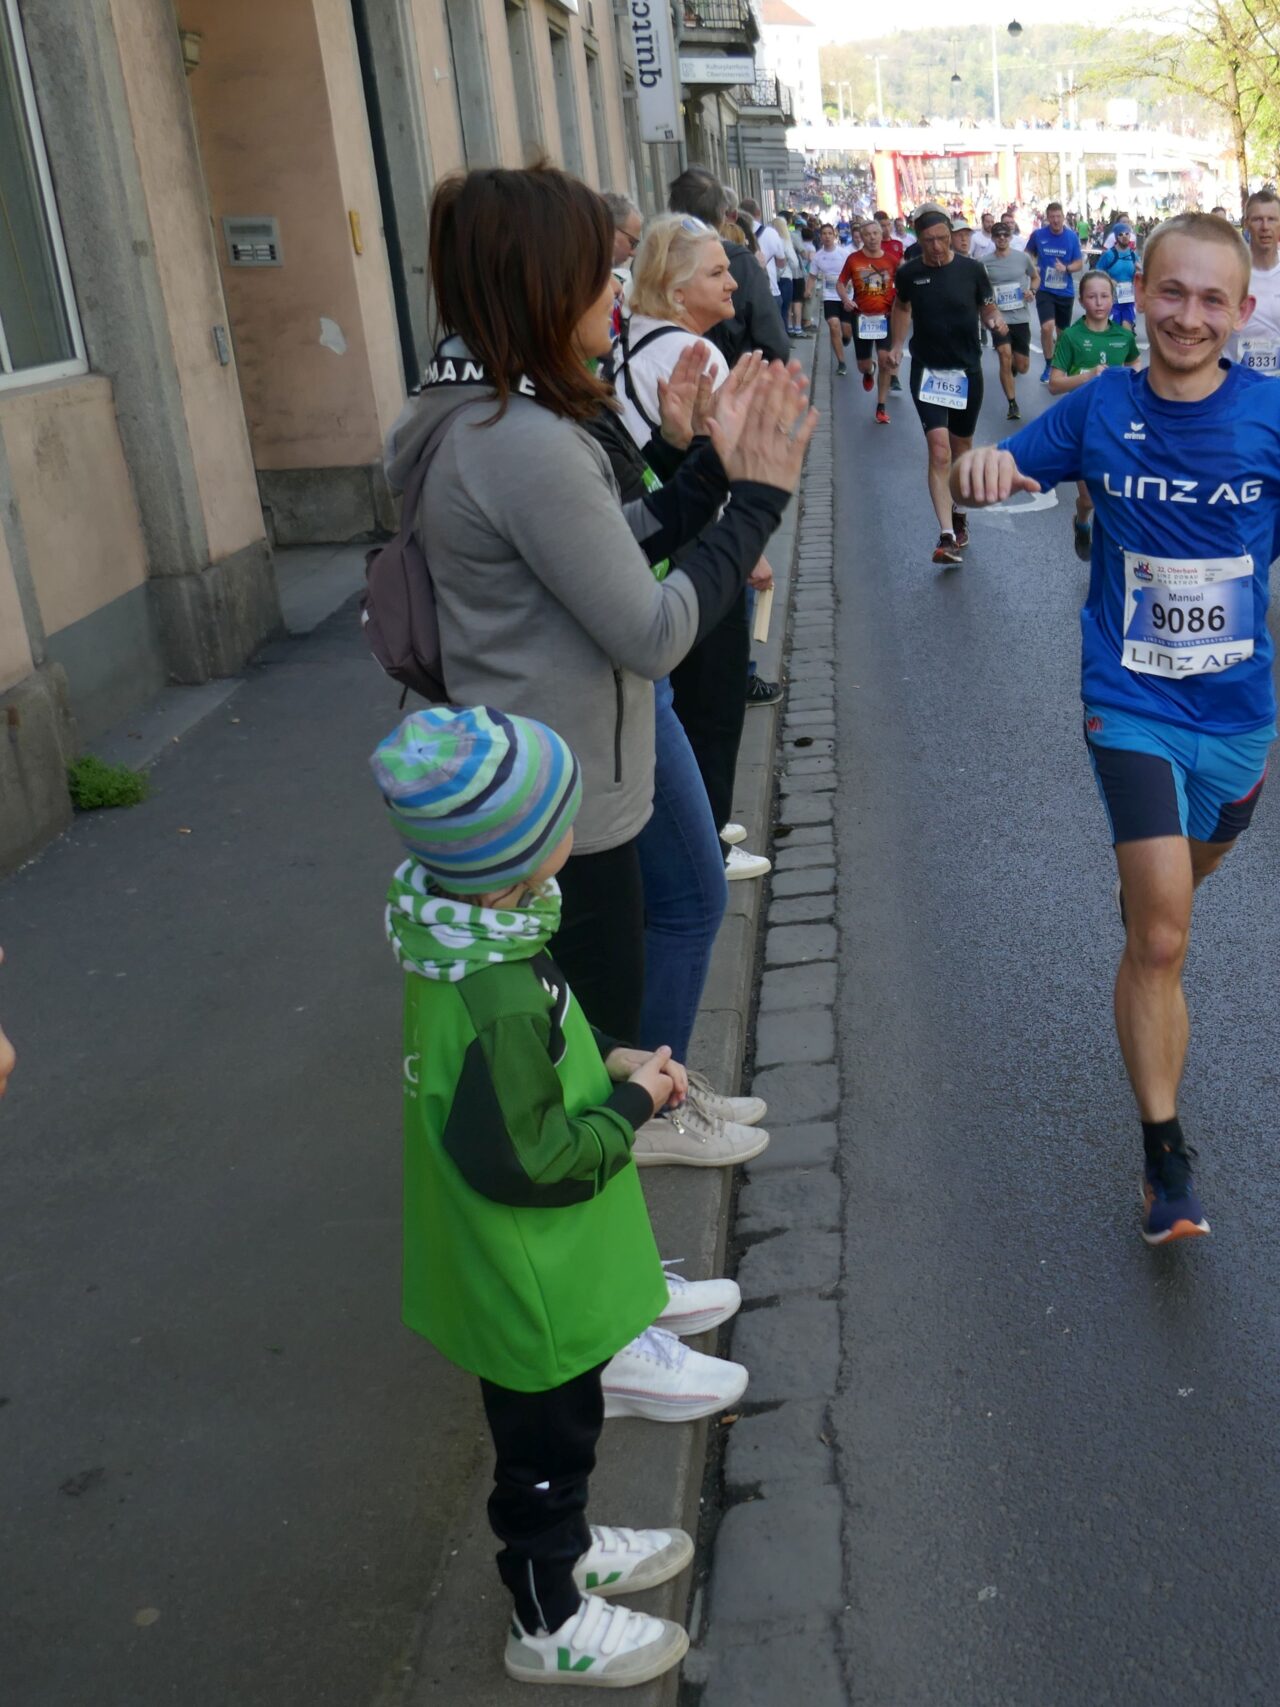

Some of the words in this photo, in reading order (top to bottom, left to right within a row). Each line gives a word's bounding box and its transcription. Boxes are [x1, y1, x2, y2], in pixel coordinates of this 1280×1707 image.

[632, 0, 662, 88] quitc
[1100, 352, 1107, 364] 3
[1248, 356, 1277, 368] 8331
[929, 379, 962, 394] 11652
[1103, 472, 1199, 504] LINZ
[1207, 479, 1264, 505] AG
[1168, 593, 1204, 602] Manuel
[1151, 602, 1225, 634] 9086
[1131, 648, 1194, 671] LINZ
[1202, 652, 1243, 670] AG
